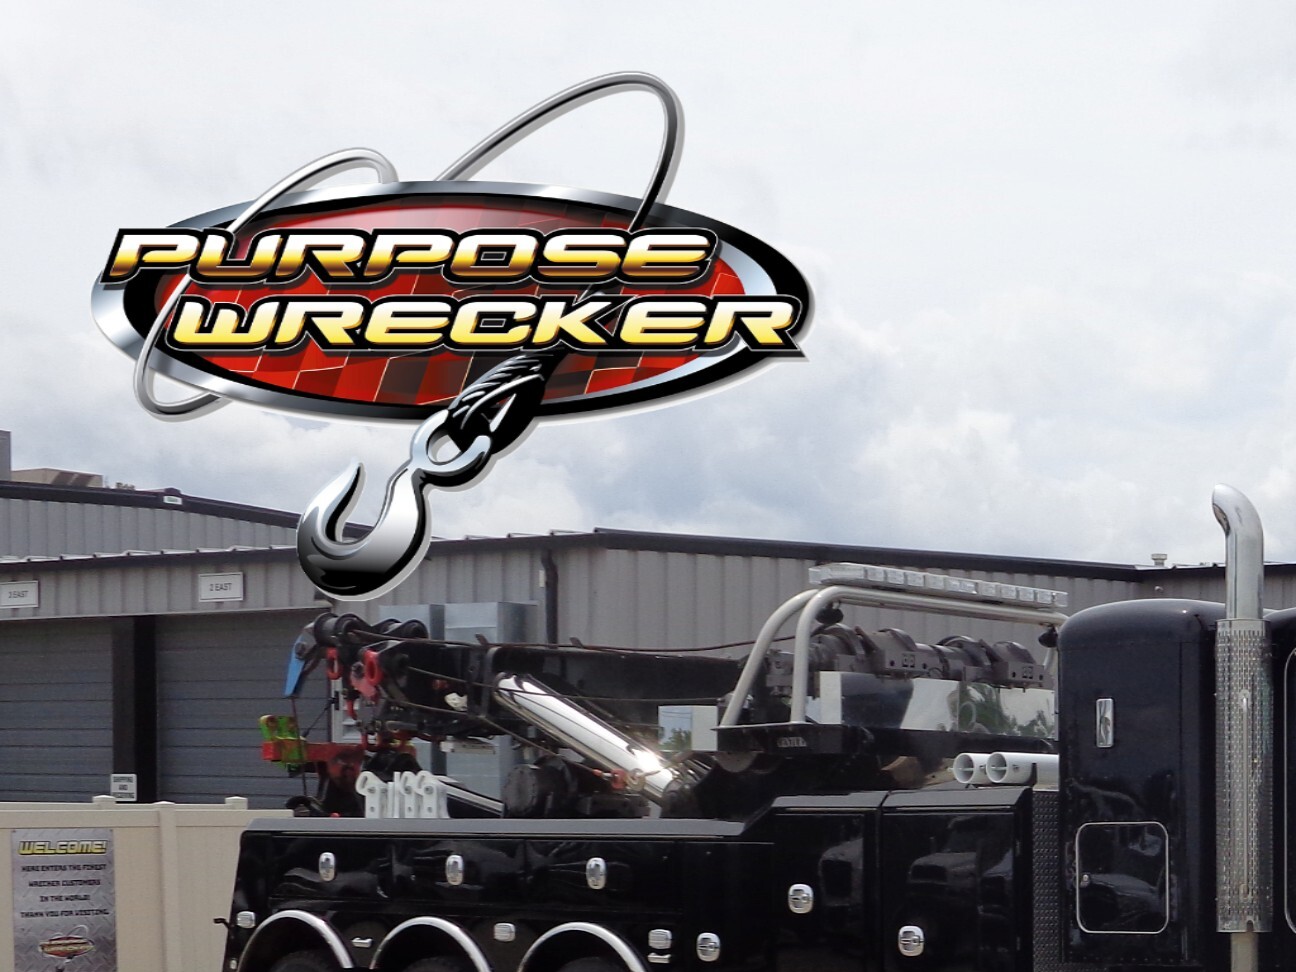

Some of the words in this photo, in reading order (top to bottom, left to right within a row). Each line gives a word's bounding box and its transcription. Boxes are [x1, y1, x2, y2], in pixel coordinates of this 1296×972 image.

[215, 582, 232, 591] EAST
[18, 840, 107, 855] WELCOME!
[82, 863, 107, 871] FINEST
